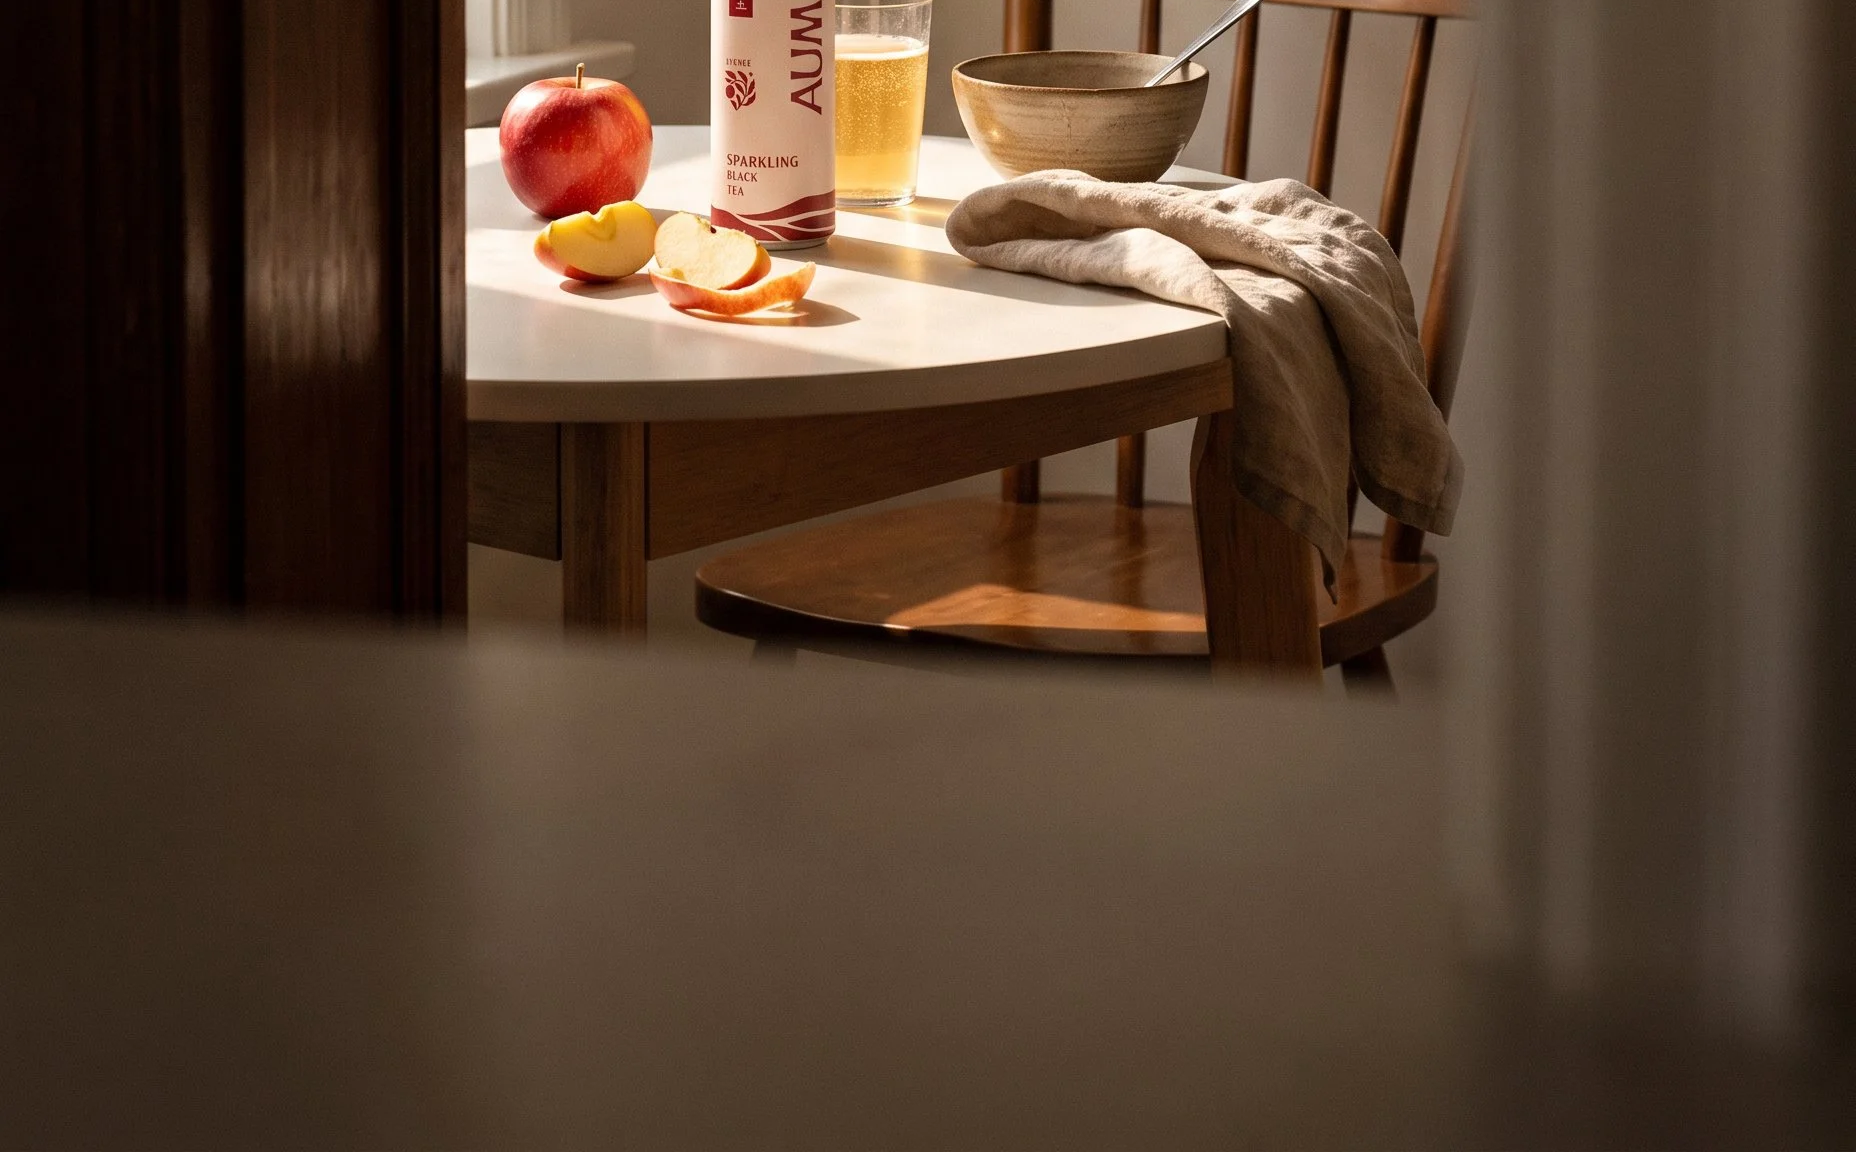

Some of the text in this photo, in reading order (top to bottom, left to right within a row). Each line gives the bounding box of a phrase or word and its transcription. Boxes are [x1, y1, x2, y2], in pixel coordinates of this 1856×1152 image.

[726, 153, 799, 168] SPARKLING
[727, 169, 758, 182] BLACK
[727, 184, 744, 196] TEA
